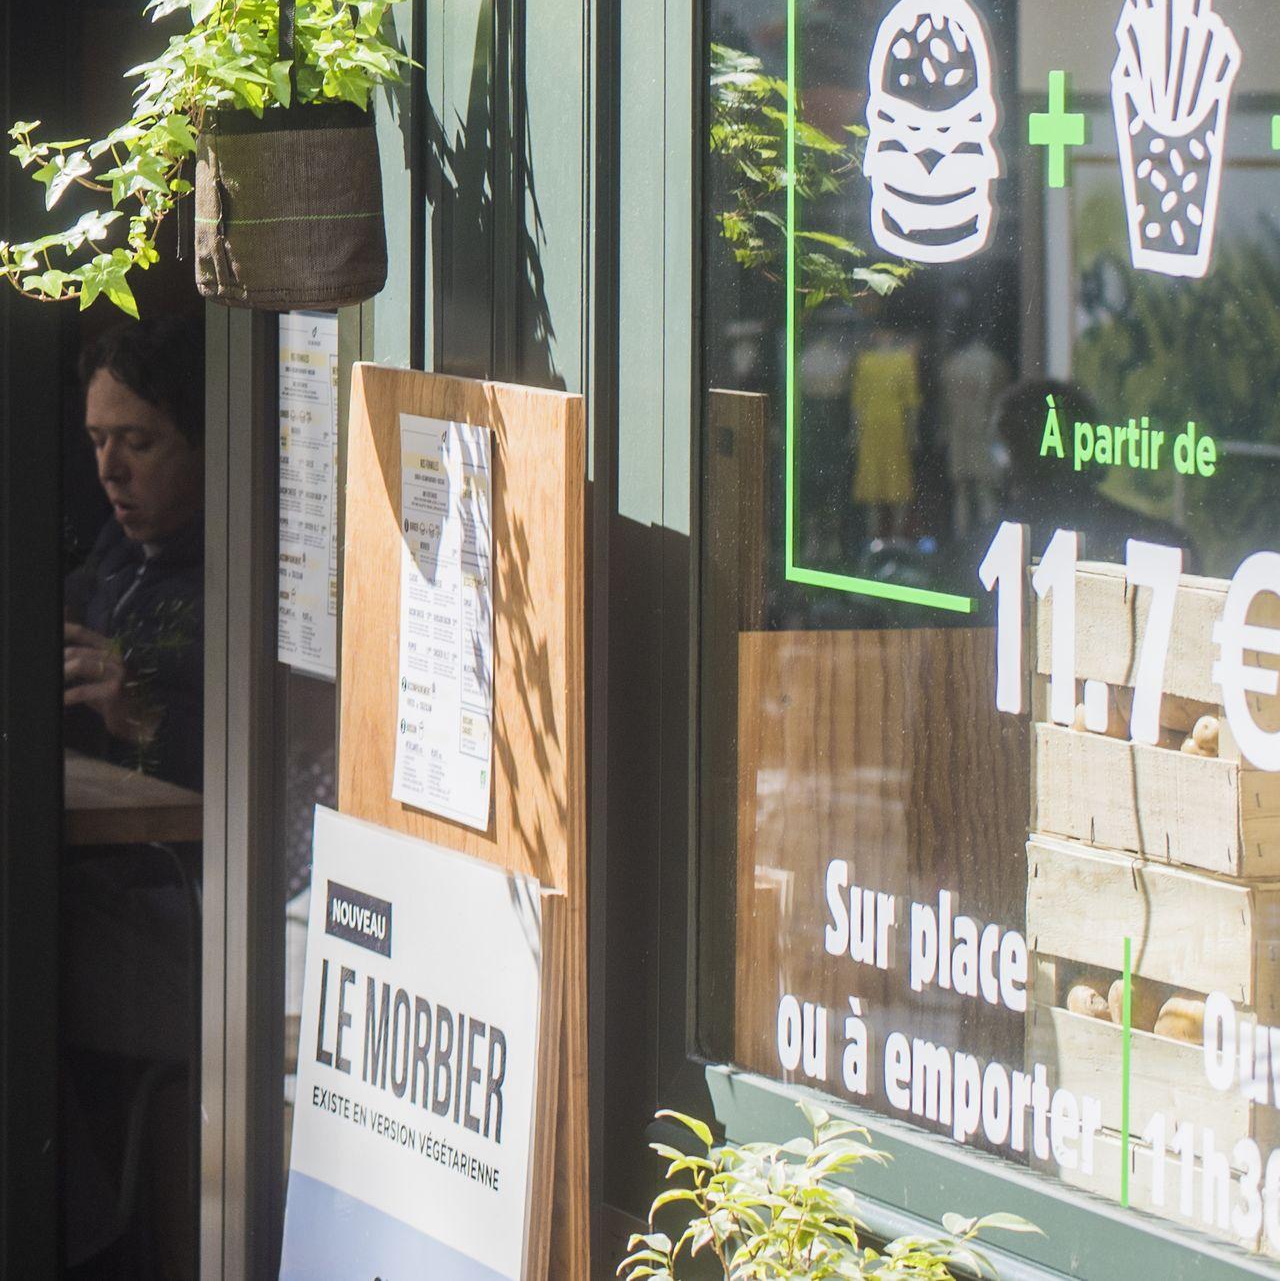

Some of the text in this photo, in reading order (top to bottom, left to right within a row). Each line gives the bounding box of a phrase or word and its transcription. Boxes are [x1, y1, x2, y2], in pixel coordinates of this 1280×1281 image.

[1040, 393, 1217, 478] À partir de
[332, 896, 386, 940] NOUVEAU
[824, 859, 1028, 1013] Sur place
[315, 959, 507, 1144] LE MORBIER
[777, 994, 1102, 1175] ou à emporter
[313, 1085, 500, 1192] EXISTE EN VERSION VÉGÉTARIENNE
